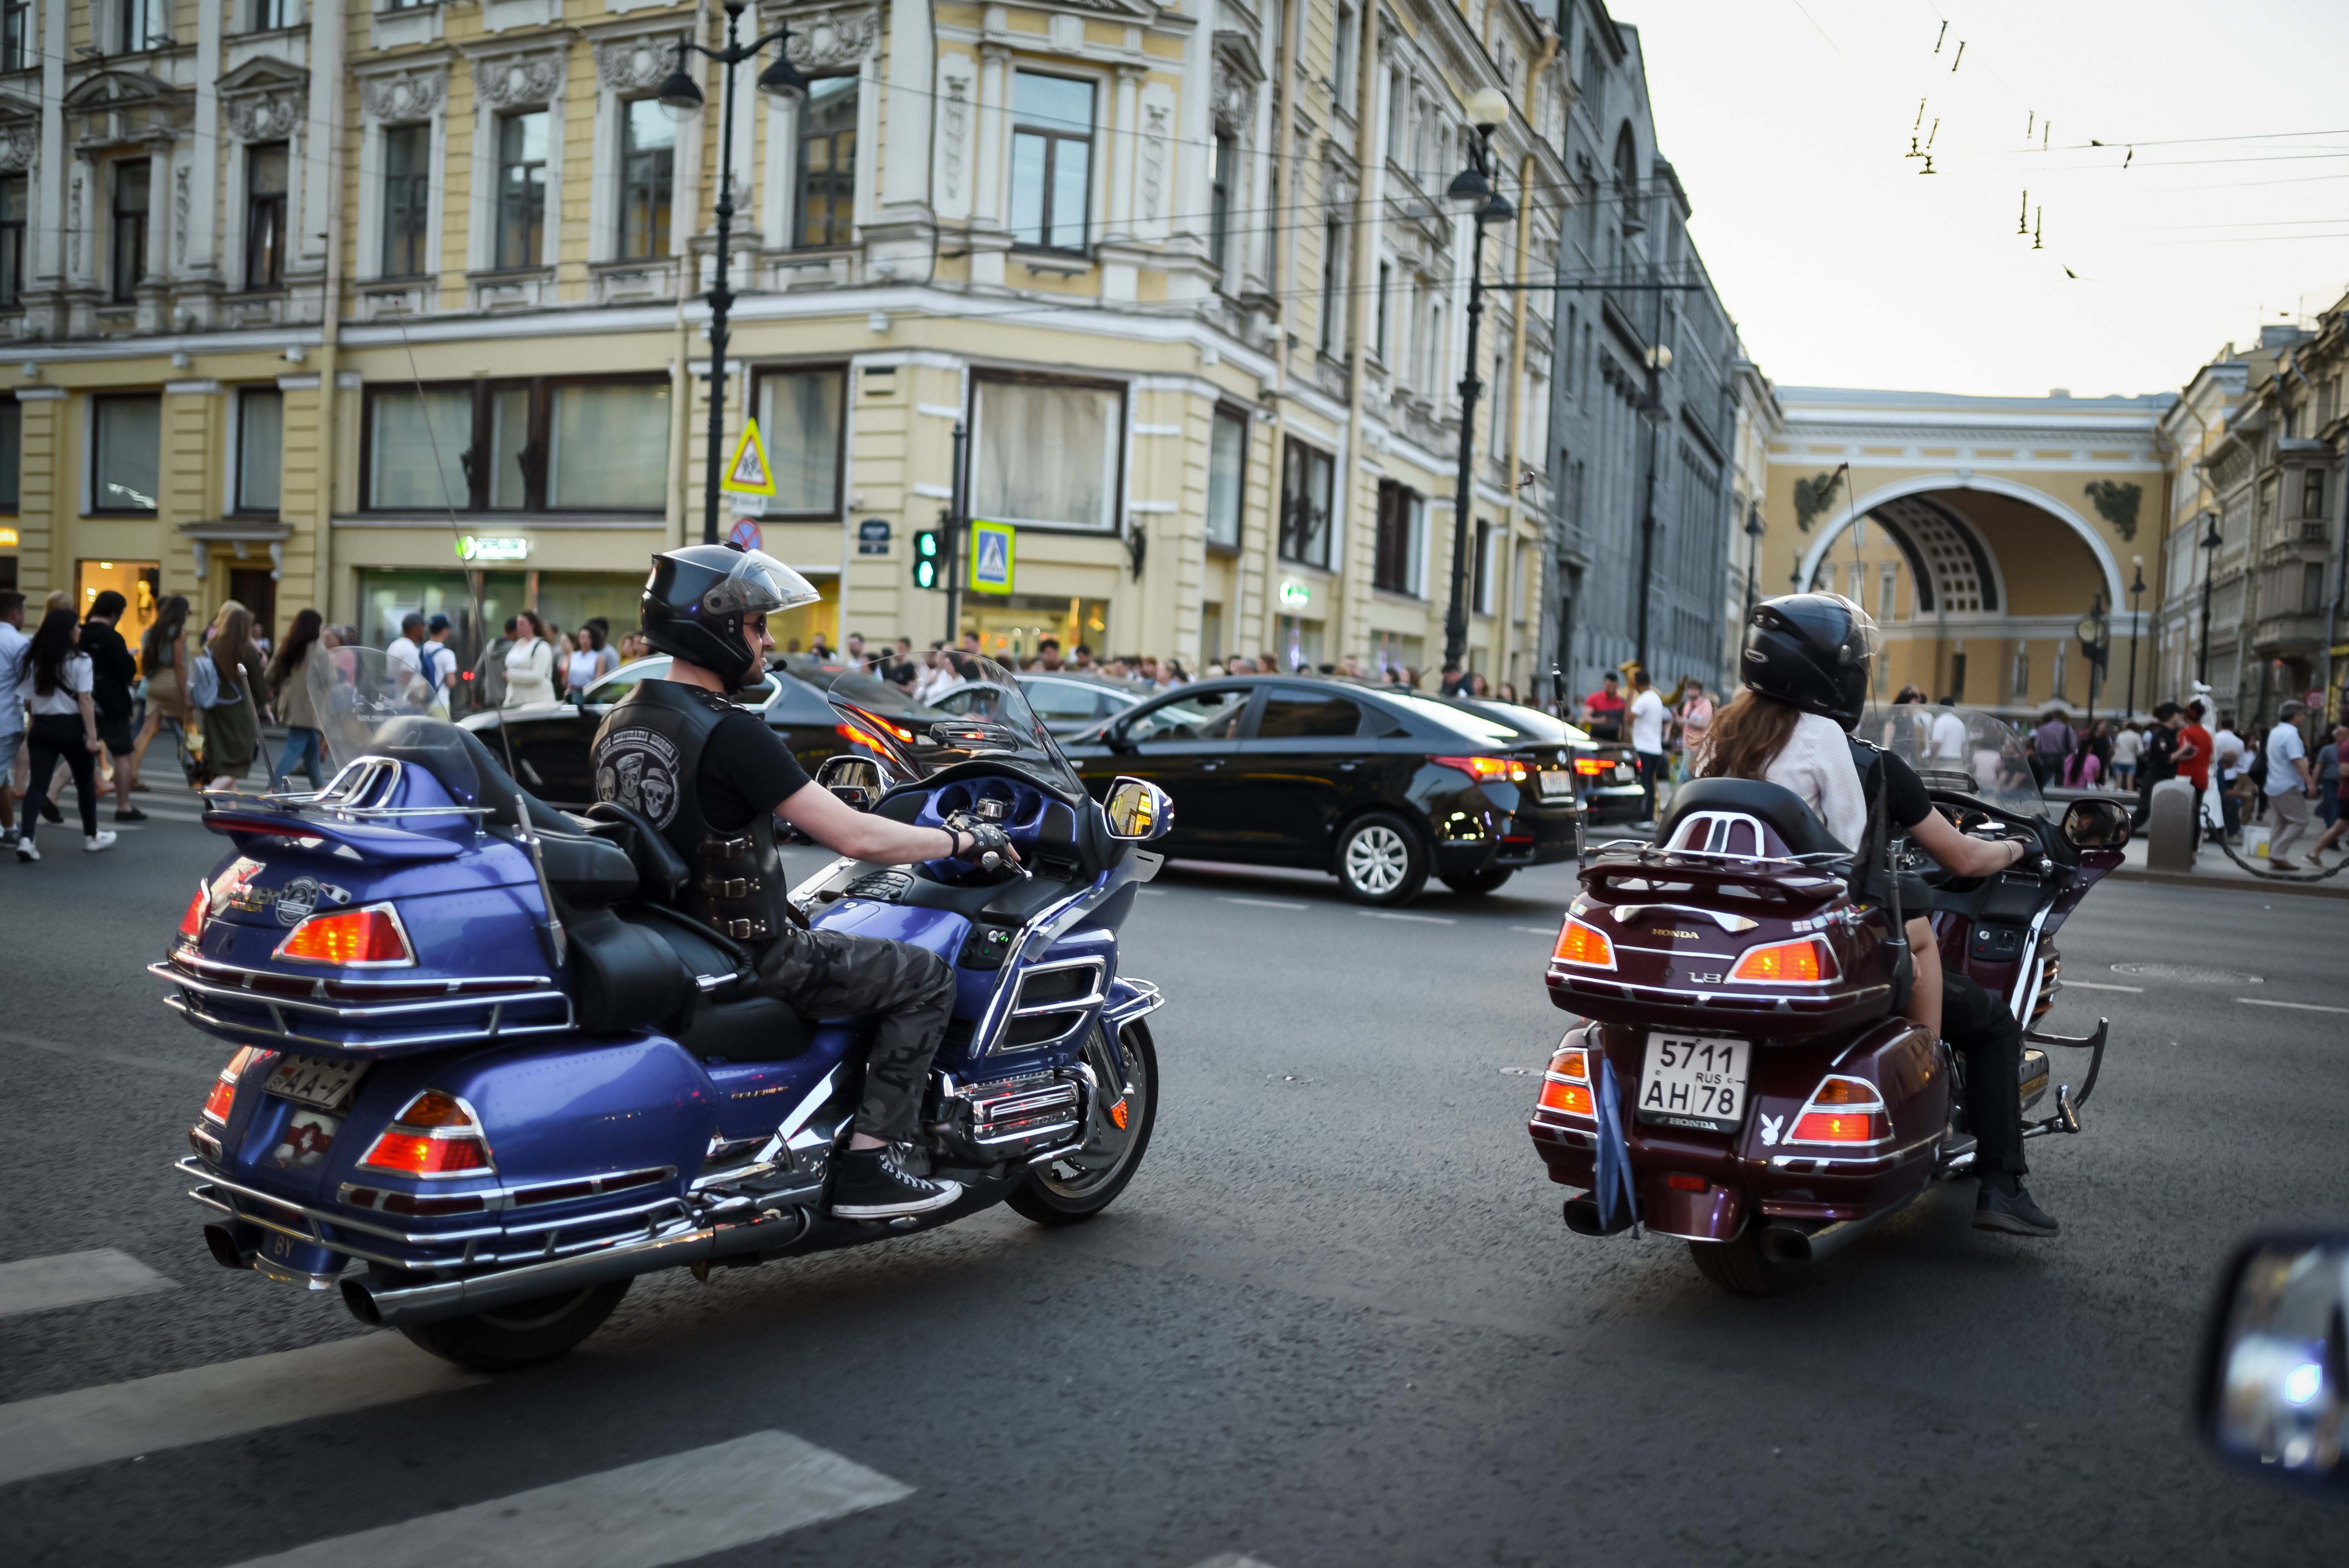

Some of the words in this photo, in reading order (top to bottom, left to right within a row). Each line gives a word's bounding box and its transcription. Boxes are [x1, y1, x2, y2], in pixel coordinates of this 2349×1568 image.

[1652, 928, 1700, 939] HONDA
[1660, 1040, 1733, 1074] 5711
[1695, 1072, 1722, 1084] RUS
[1644, 1080, 1690, 1110] AH
[1701, 1085, 1734, 1115] 78
[1668, 1117, 1719, 1130] HONDA
[274, 1234, 295, 1258] BY
